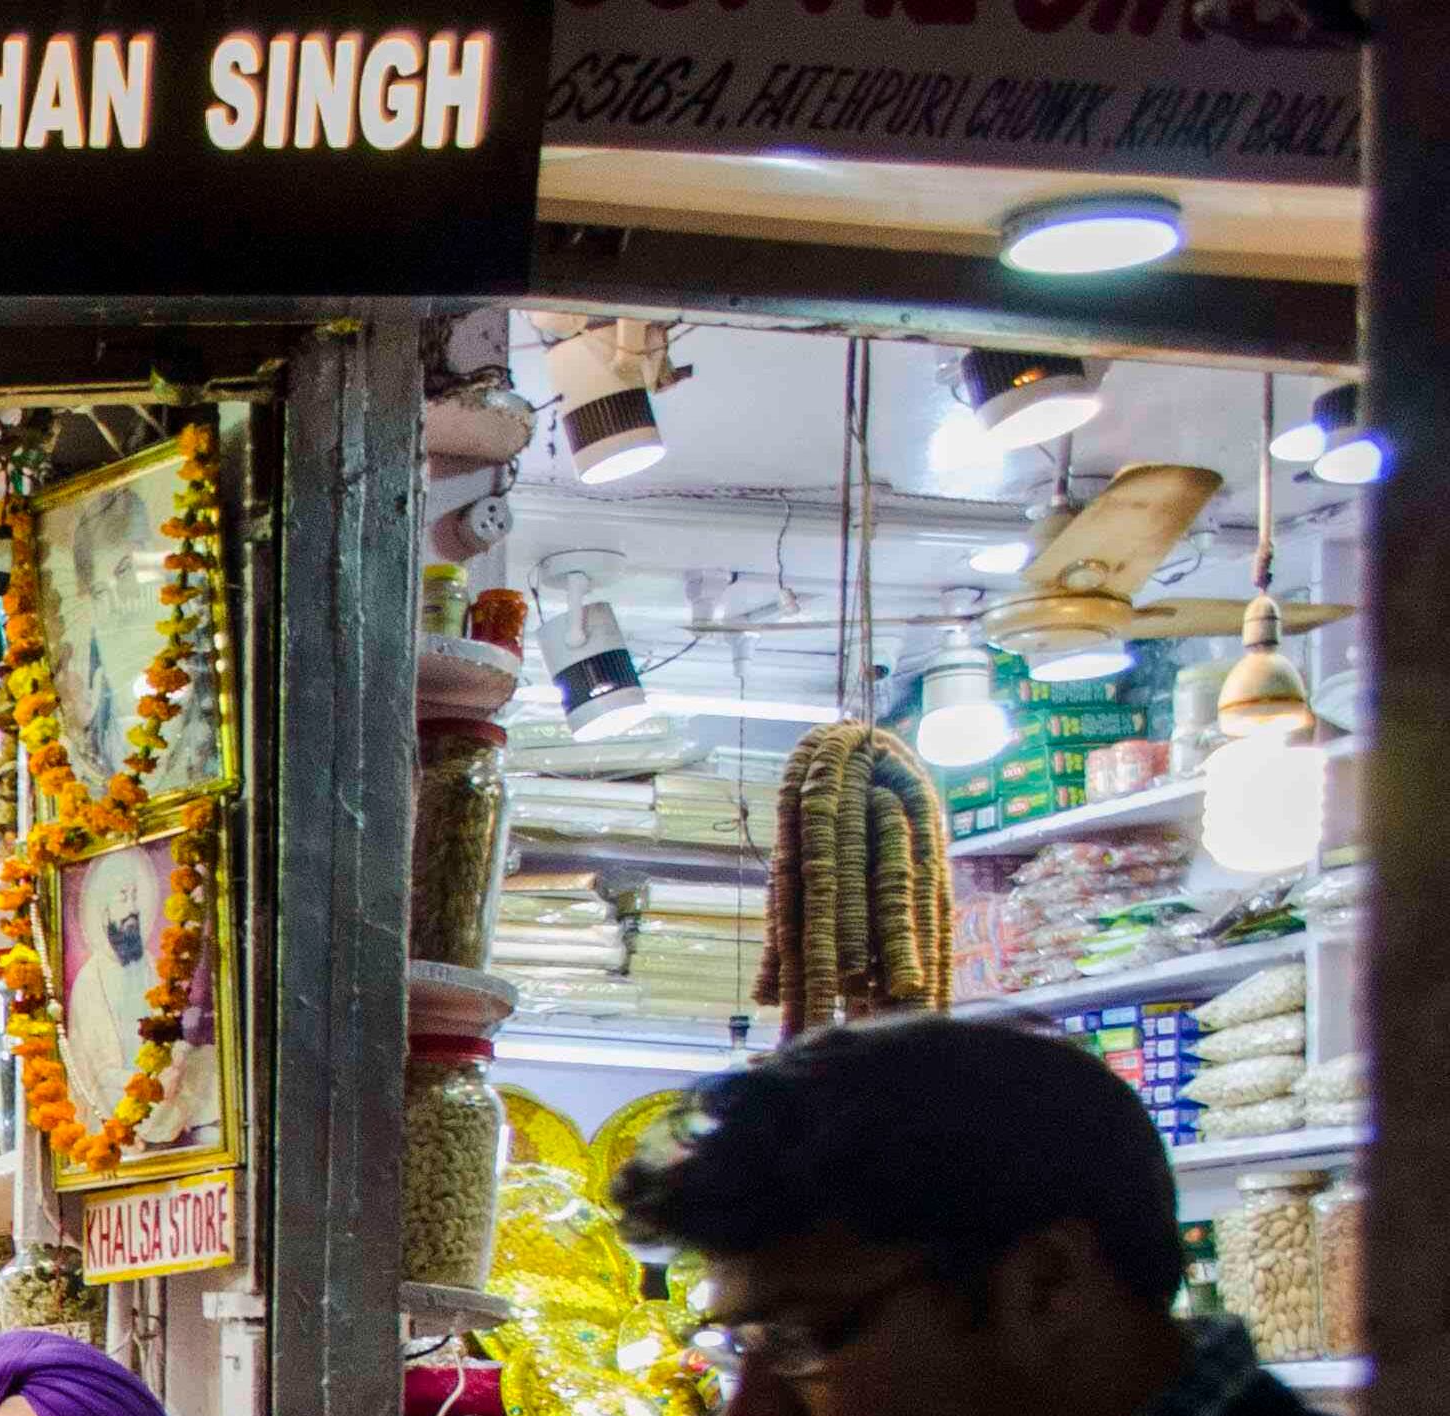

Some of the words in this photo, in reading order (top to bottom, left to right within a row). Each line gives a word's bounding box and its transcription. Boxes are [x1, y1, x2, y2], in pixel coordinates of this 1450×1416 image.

[204, 33, 491, 150] SINGH
[737, 62, 971, 138] FATEHPURI
[85, 1198, 164, 1270] KHALSA
[168, 1183, 230, 1259] STORE
